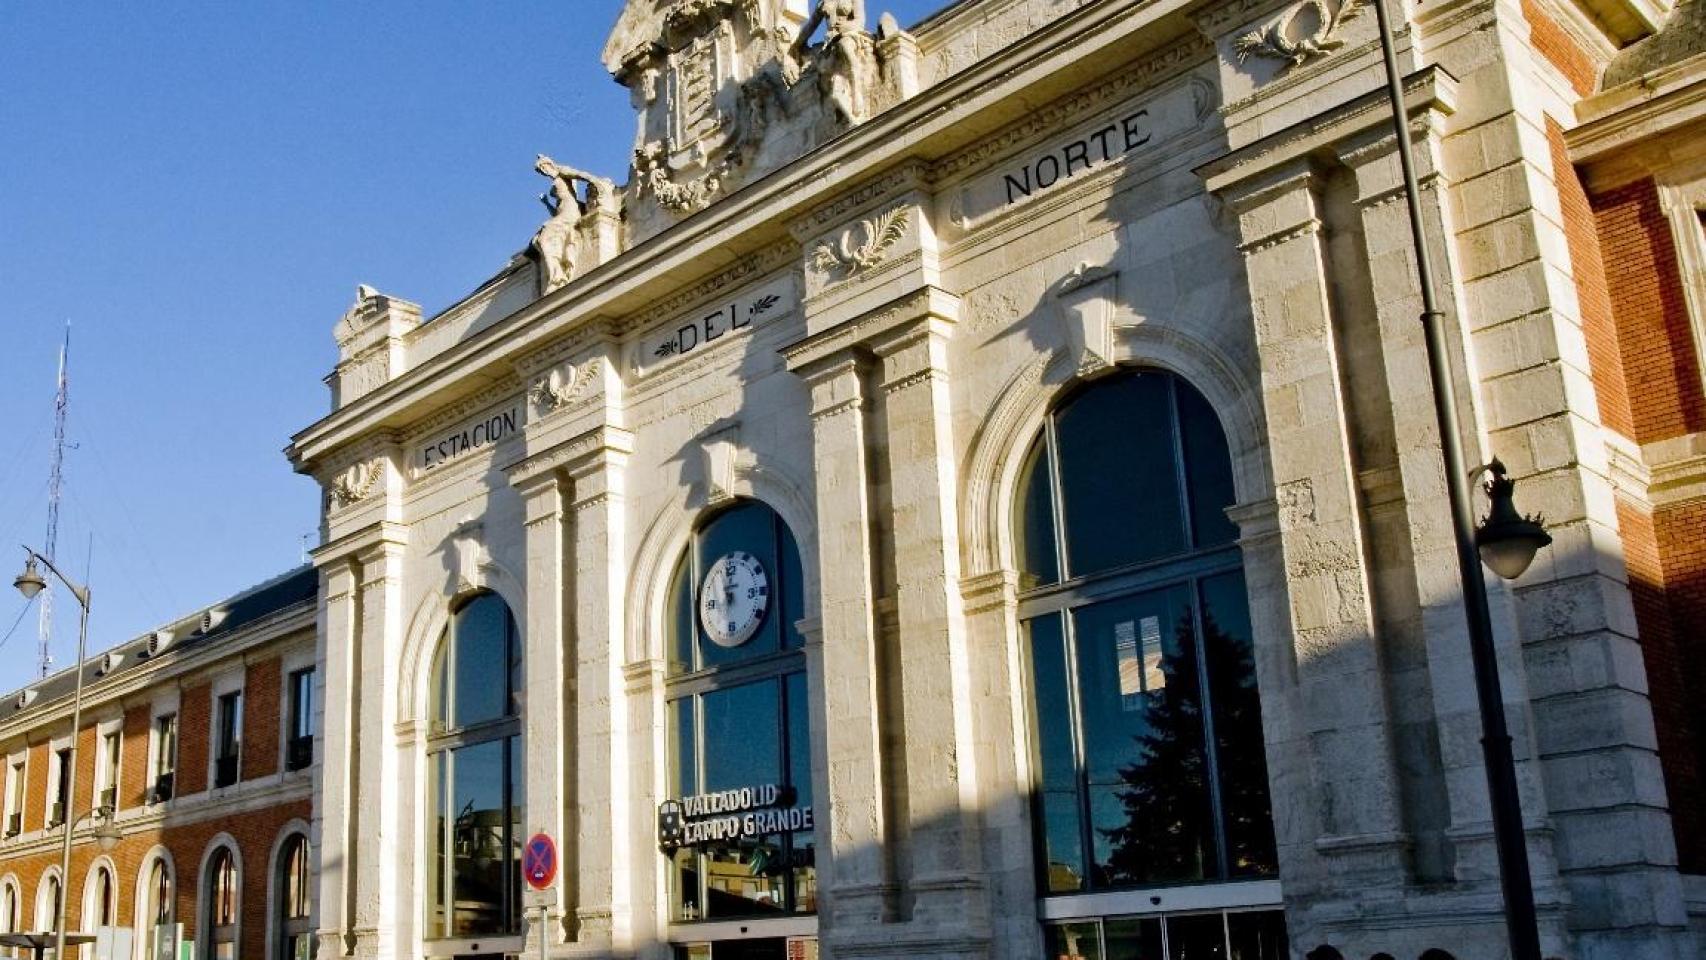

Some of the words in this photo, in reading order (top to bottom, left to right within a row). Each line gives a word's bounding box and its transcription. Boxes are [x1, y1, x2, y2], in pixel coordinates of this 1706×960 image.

[424, 408, 516, 470] ESTACION
[678, 304, 751, 354] DEL
[1003, 109, 1151, 204] NORTE
[747, 587, 755, 599] 3
[682, 783, 777, 817] VALLADOLID
[684, 815, 740, 844] CAMPO
[743, 806, 814, 836] GRANDE
